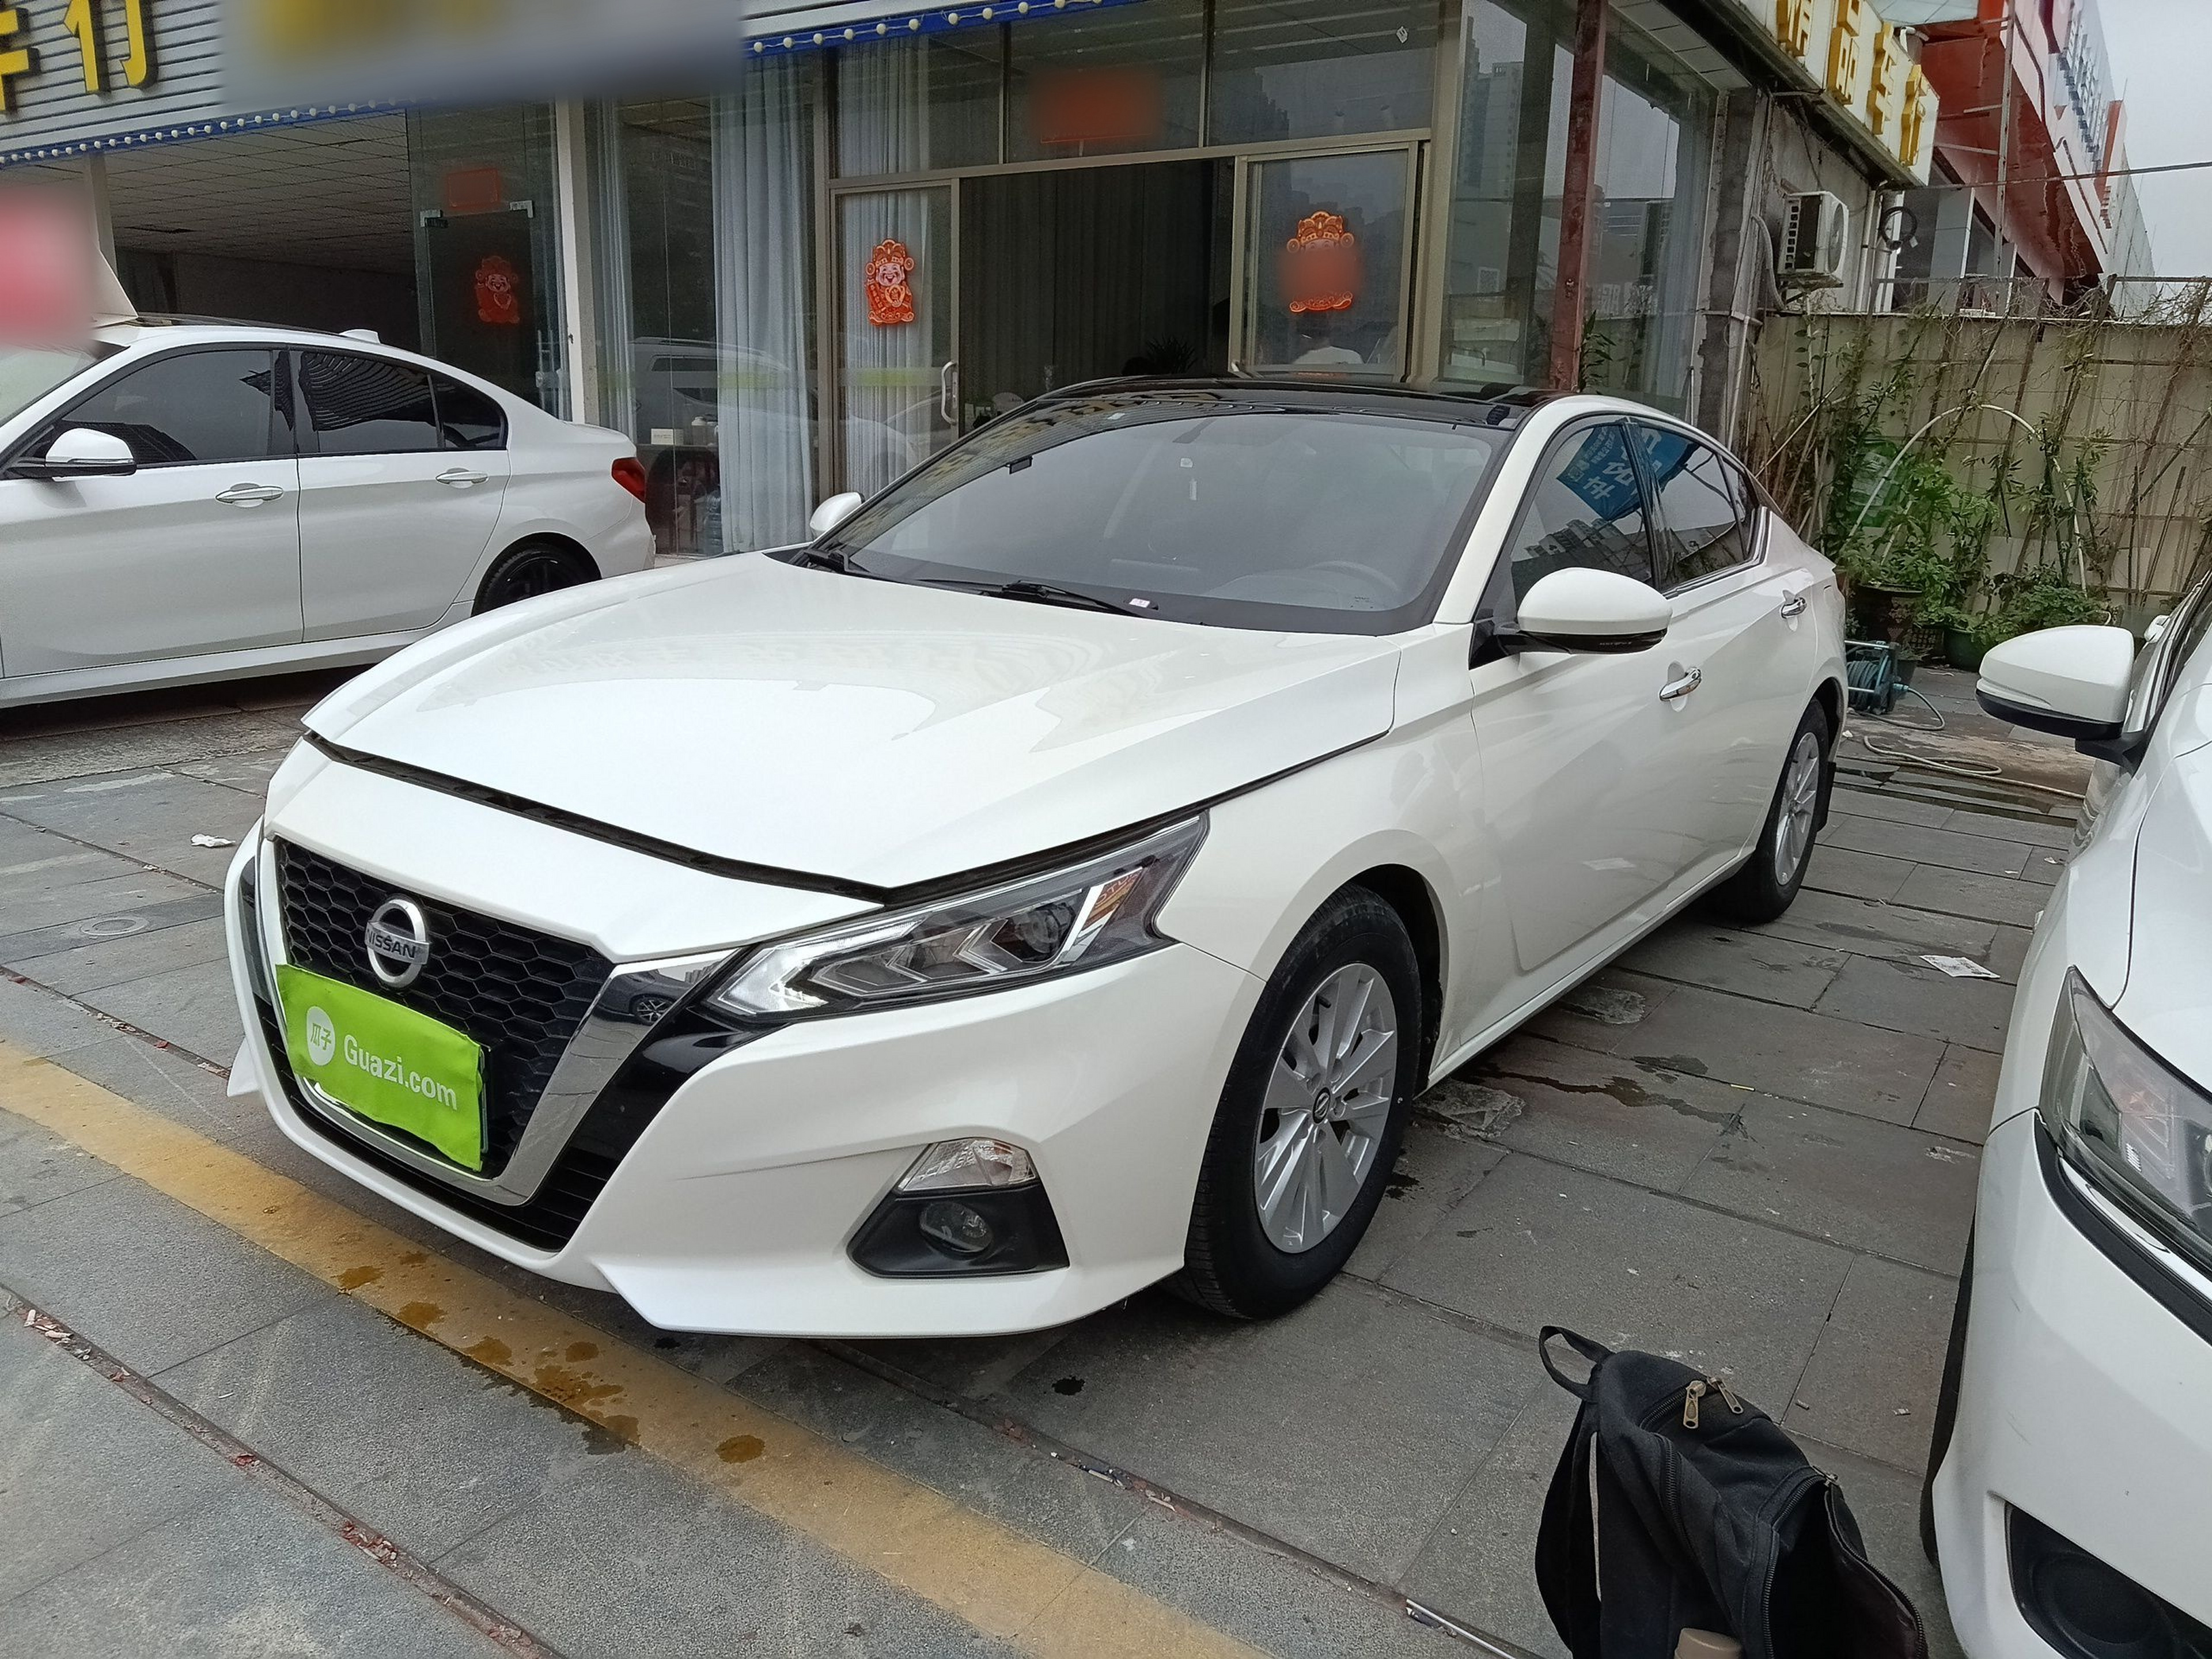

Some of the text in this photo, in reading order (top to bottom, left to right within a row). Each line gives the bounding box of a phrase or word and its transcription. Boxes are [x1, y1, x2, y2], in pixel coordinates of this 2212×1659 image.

[366, 927, 416, 959] NISSAN
[310, 1022, 332, 1051] 瓜子
[343, 1034, 457, 1111] Guazi.com
